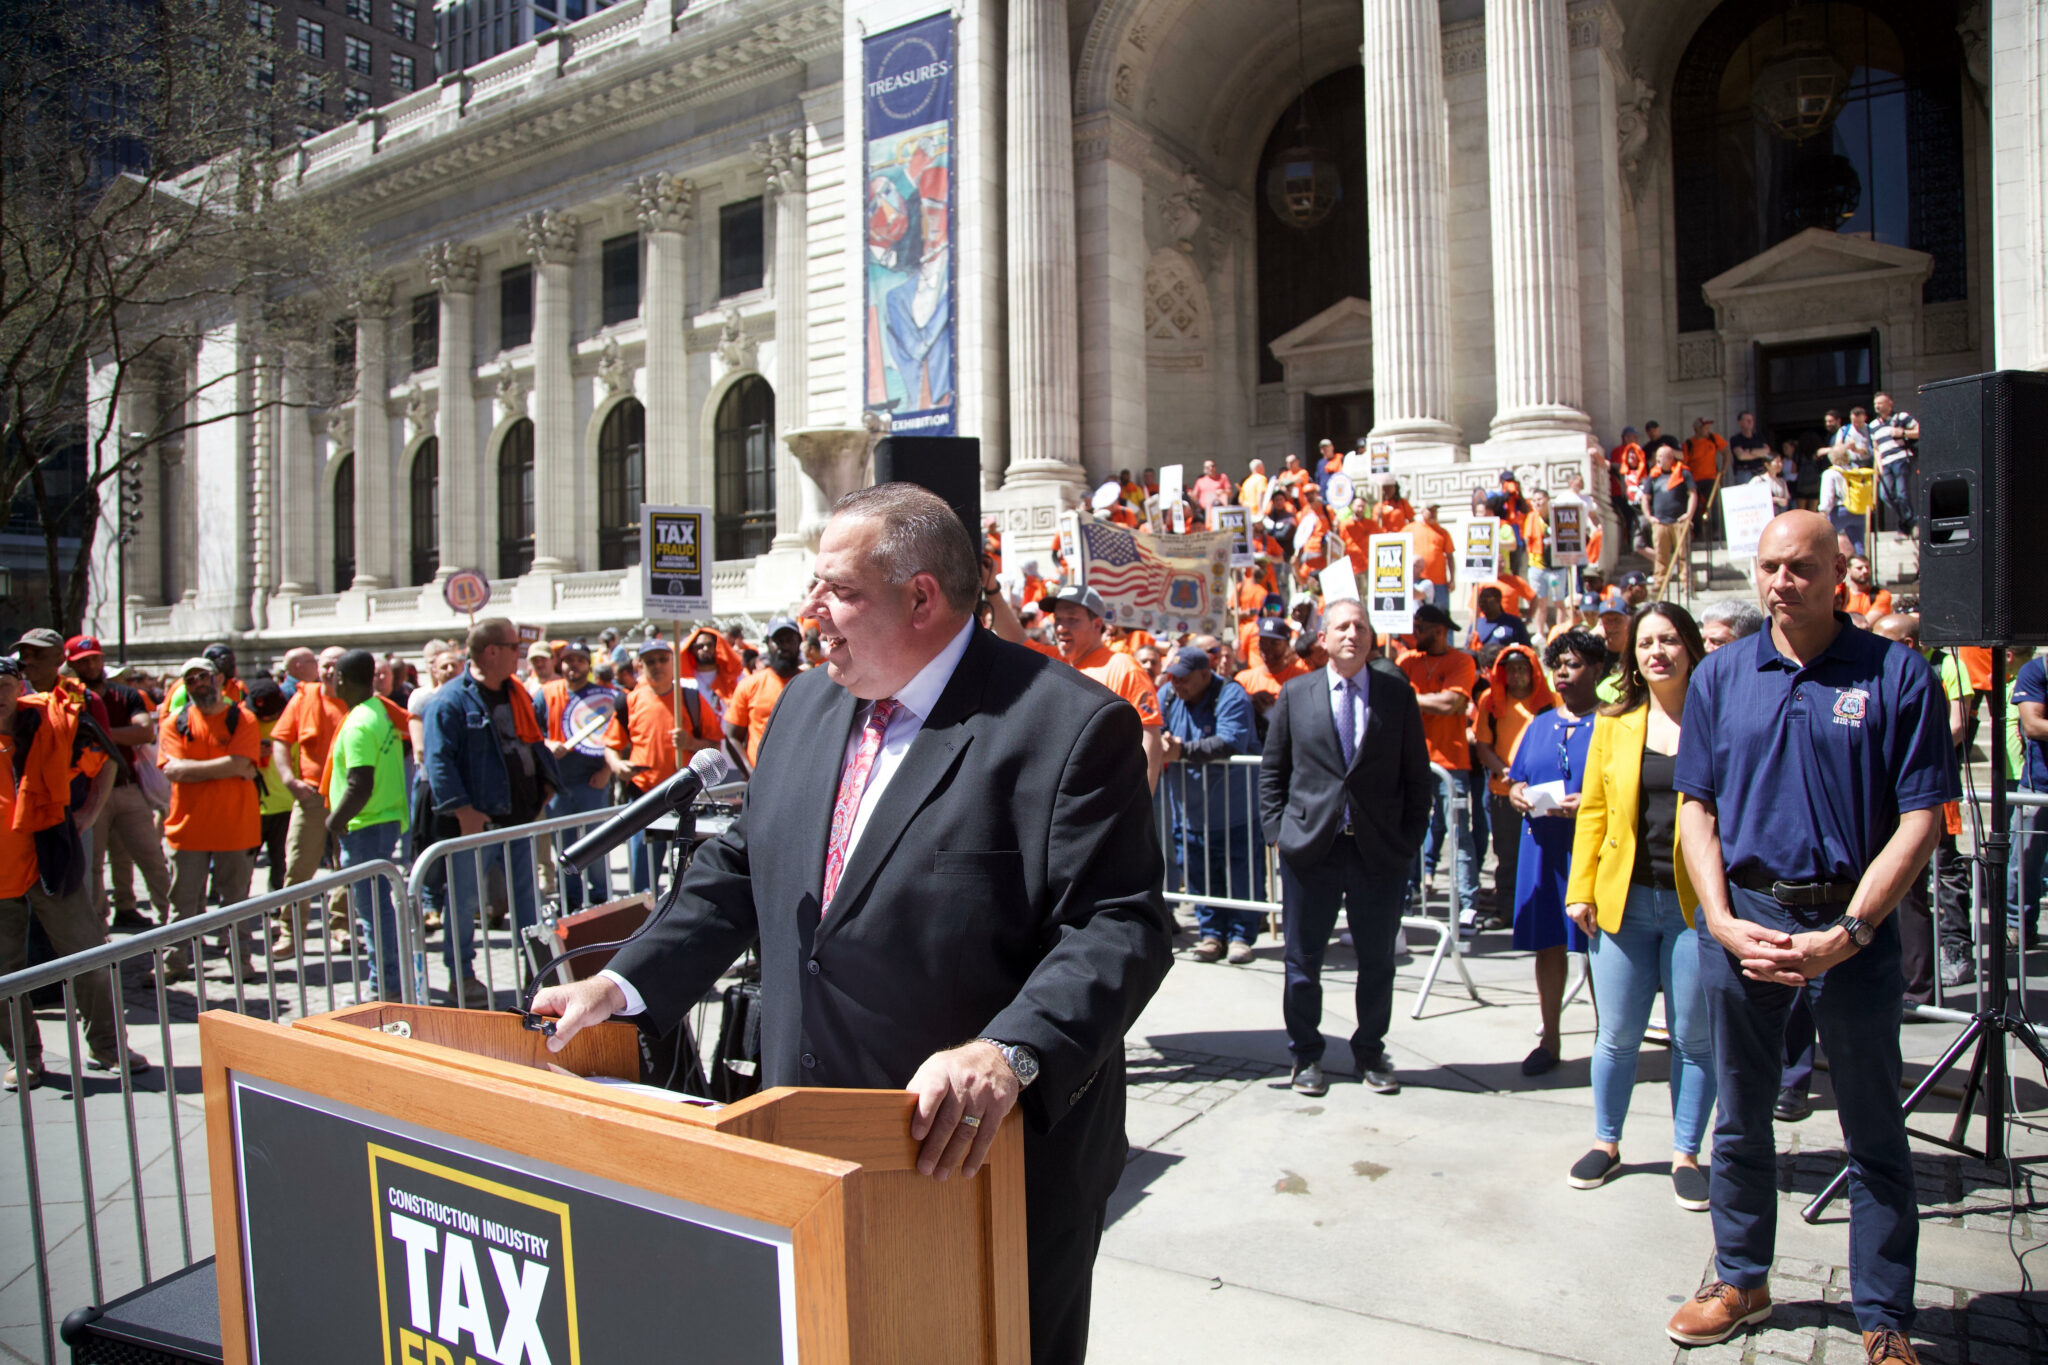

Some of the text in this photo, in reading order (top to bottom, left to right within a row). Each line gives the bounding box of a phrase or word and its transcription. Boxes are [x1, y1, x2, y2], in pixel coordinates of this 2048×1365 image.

[868, 60, 948, 97] TREASURES
[891, 413, 950, 432] EXHIBITION
[1221, 515, 1243, 528] TAX
[1558, 511, 1577, 523] TAX
[656, 525, 695, 545] TAX
[1470, 527, 1491, 540] TAX
[656, 544, 695, 555] FRAUD
[1378, 549, 1402, 567] TAX
[388, 1186, 550, 1259] CONSTRUCTION INDUSTRY
[390, 1211, 552, 1365] TAX
